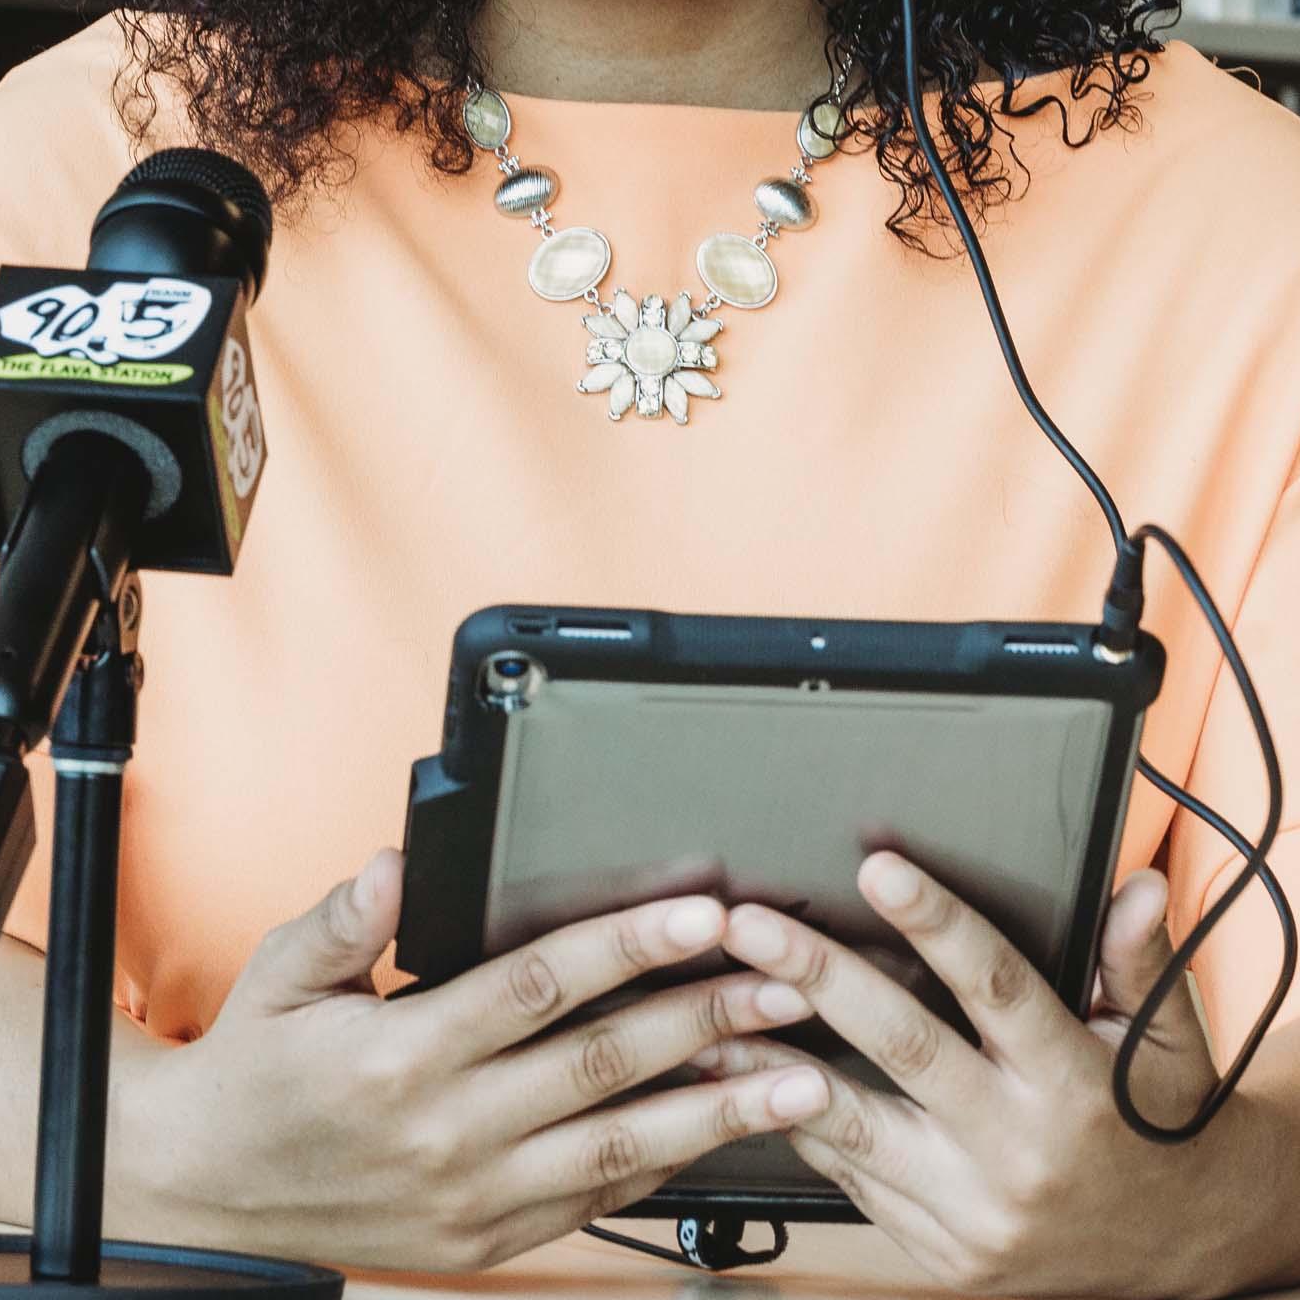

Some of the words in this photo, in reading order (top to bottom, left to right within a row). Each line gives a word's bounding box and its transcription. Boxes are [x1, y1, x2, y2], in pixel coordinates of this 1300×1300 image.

[0, 358, 33, 373] THE
[39, 361, 93, 377] FLAVA
[99, 365, 174, 382] STATION
